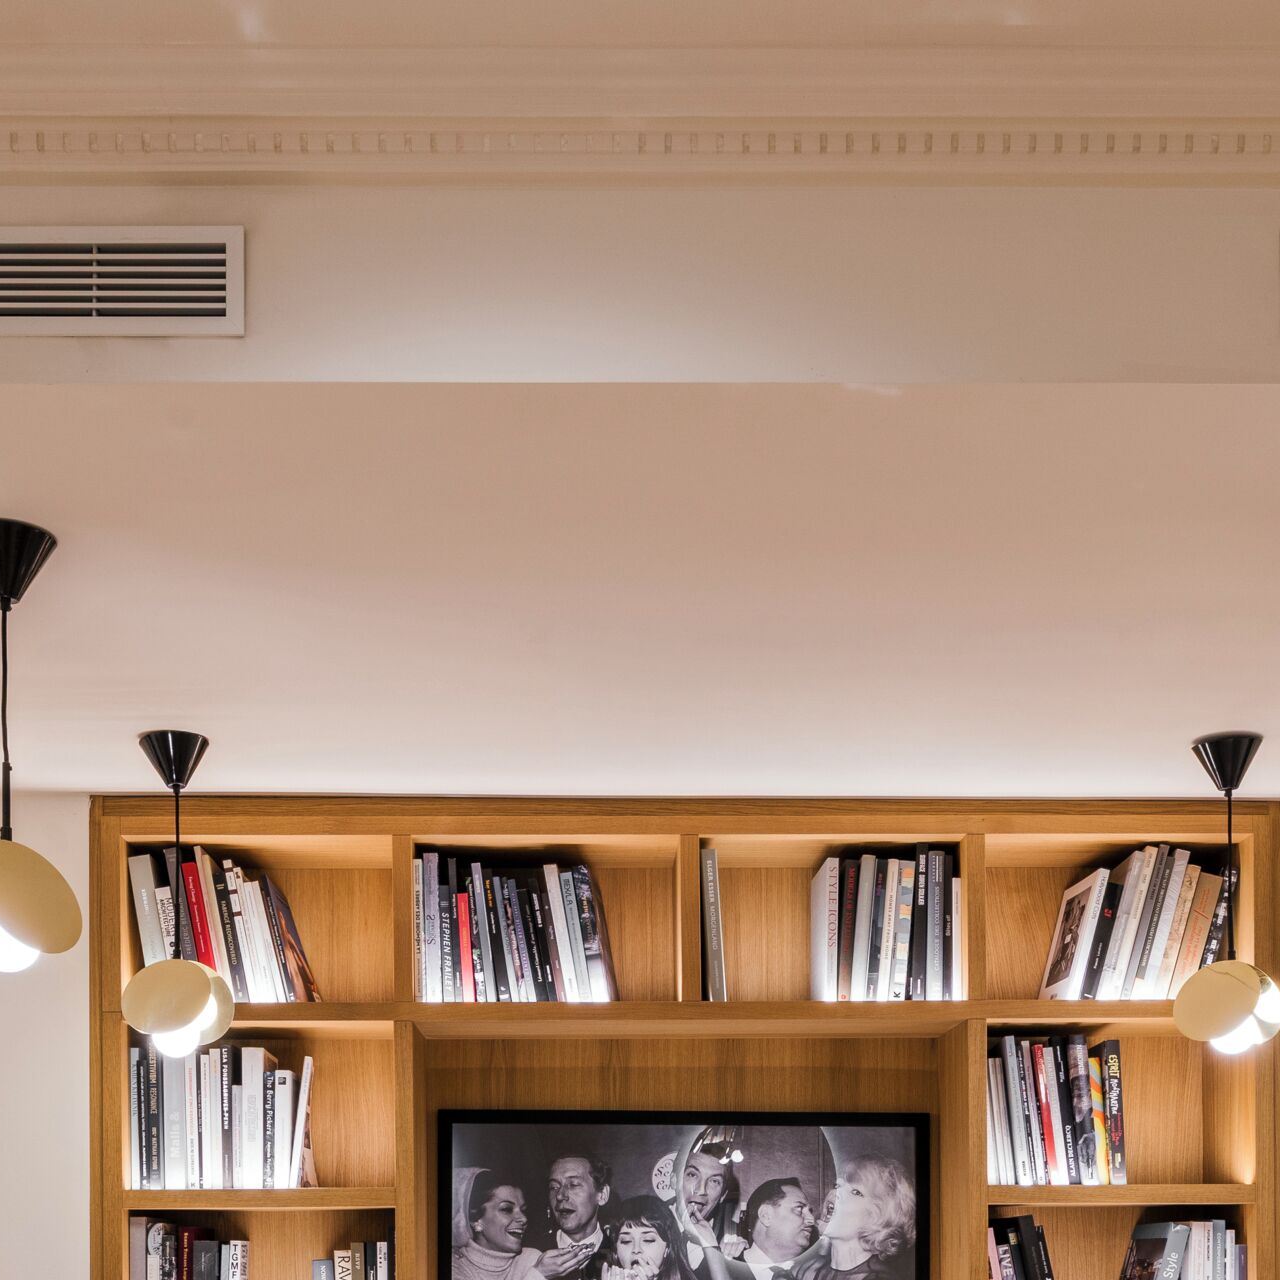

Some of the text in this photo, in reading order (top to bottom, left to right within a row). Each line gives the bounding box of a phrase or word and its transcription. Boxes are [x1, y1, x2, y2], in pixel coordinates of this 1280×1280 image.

[847, 867, 855, 898] MODELS
[1094, 876, 1106, 905] Hollywood
[159, 899, 170, 937] ARCHITECTURE
[828, 866, 837, 948] STYLE ICONS
[710, 906, 718, 950] MORGENLAND
[224, 924, 237, 965] REDISCOVERED
[441, 912, 452, 992] STEPHEN FRAILEY
[1076, 1044, 1085, 1075] SIMONIN
[1108, 1054, 1119, 1078] ESPRIT
[265, 1090, 273, 1109] Berry
[1065, 1125, 1074, 1156] DECLERCQ
[998, 1246, 1013, 1277] LIVE
[1163, 1252, 1179, 1278] Style
